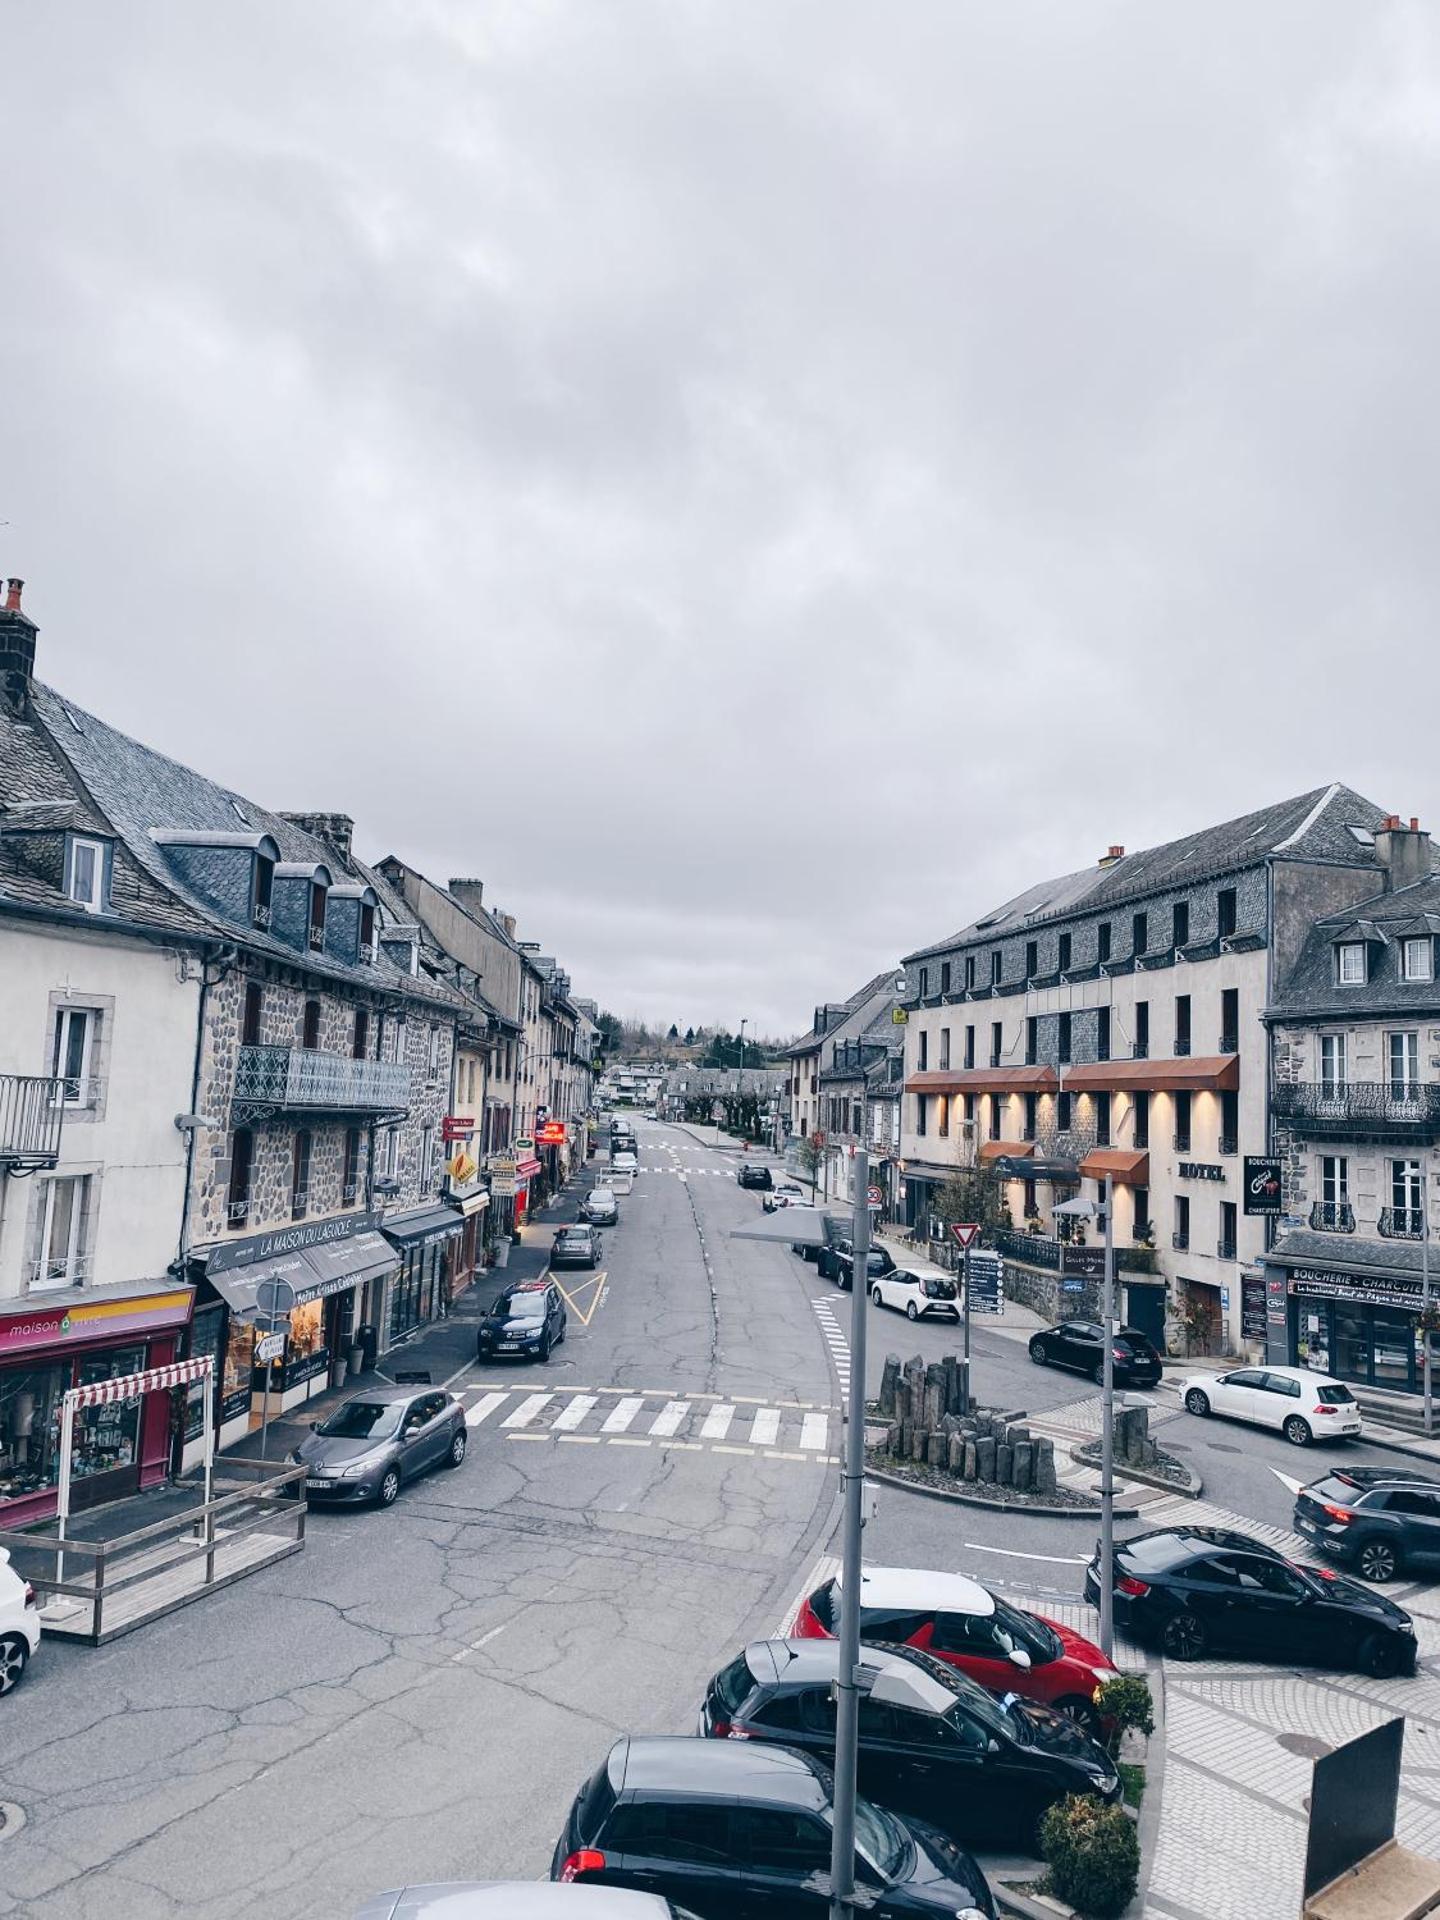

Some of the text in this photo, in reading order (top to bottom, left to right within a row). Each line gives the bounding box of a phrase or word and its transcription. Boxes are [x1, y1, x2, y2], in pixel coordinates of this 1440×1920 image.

[1178, 1161, 1226, 1182] HOTEL
[1248, 1157, 1280, 1166] BOUCHERIE
[261, 1238, 272, 1255] LA
[274, 1231, 305, 1251] MAISON
[306, 1228, 317, 1243] DU
[318, 1220, 352, 1240] LAGUIOLE
[1293, 1269, 1351, 1285] BOUCHERIE
[1362, 1279, 1440, 1297] CHARCUTEIE
[9, 1320, 59, 1337] maison
